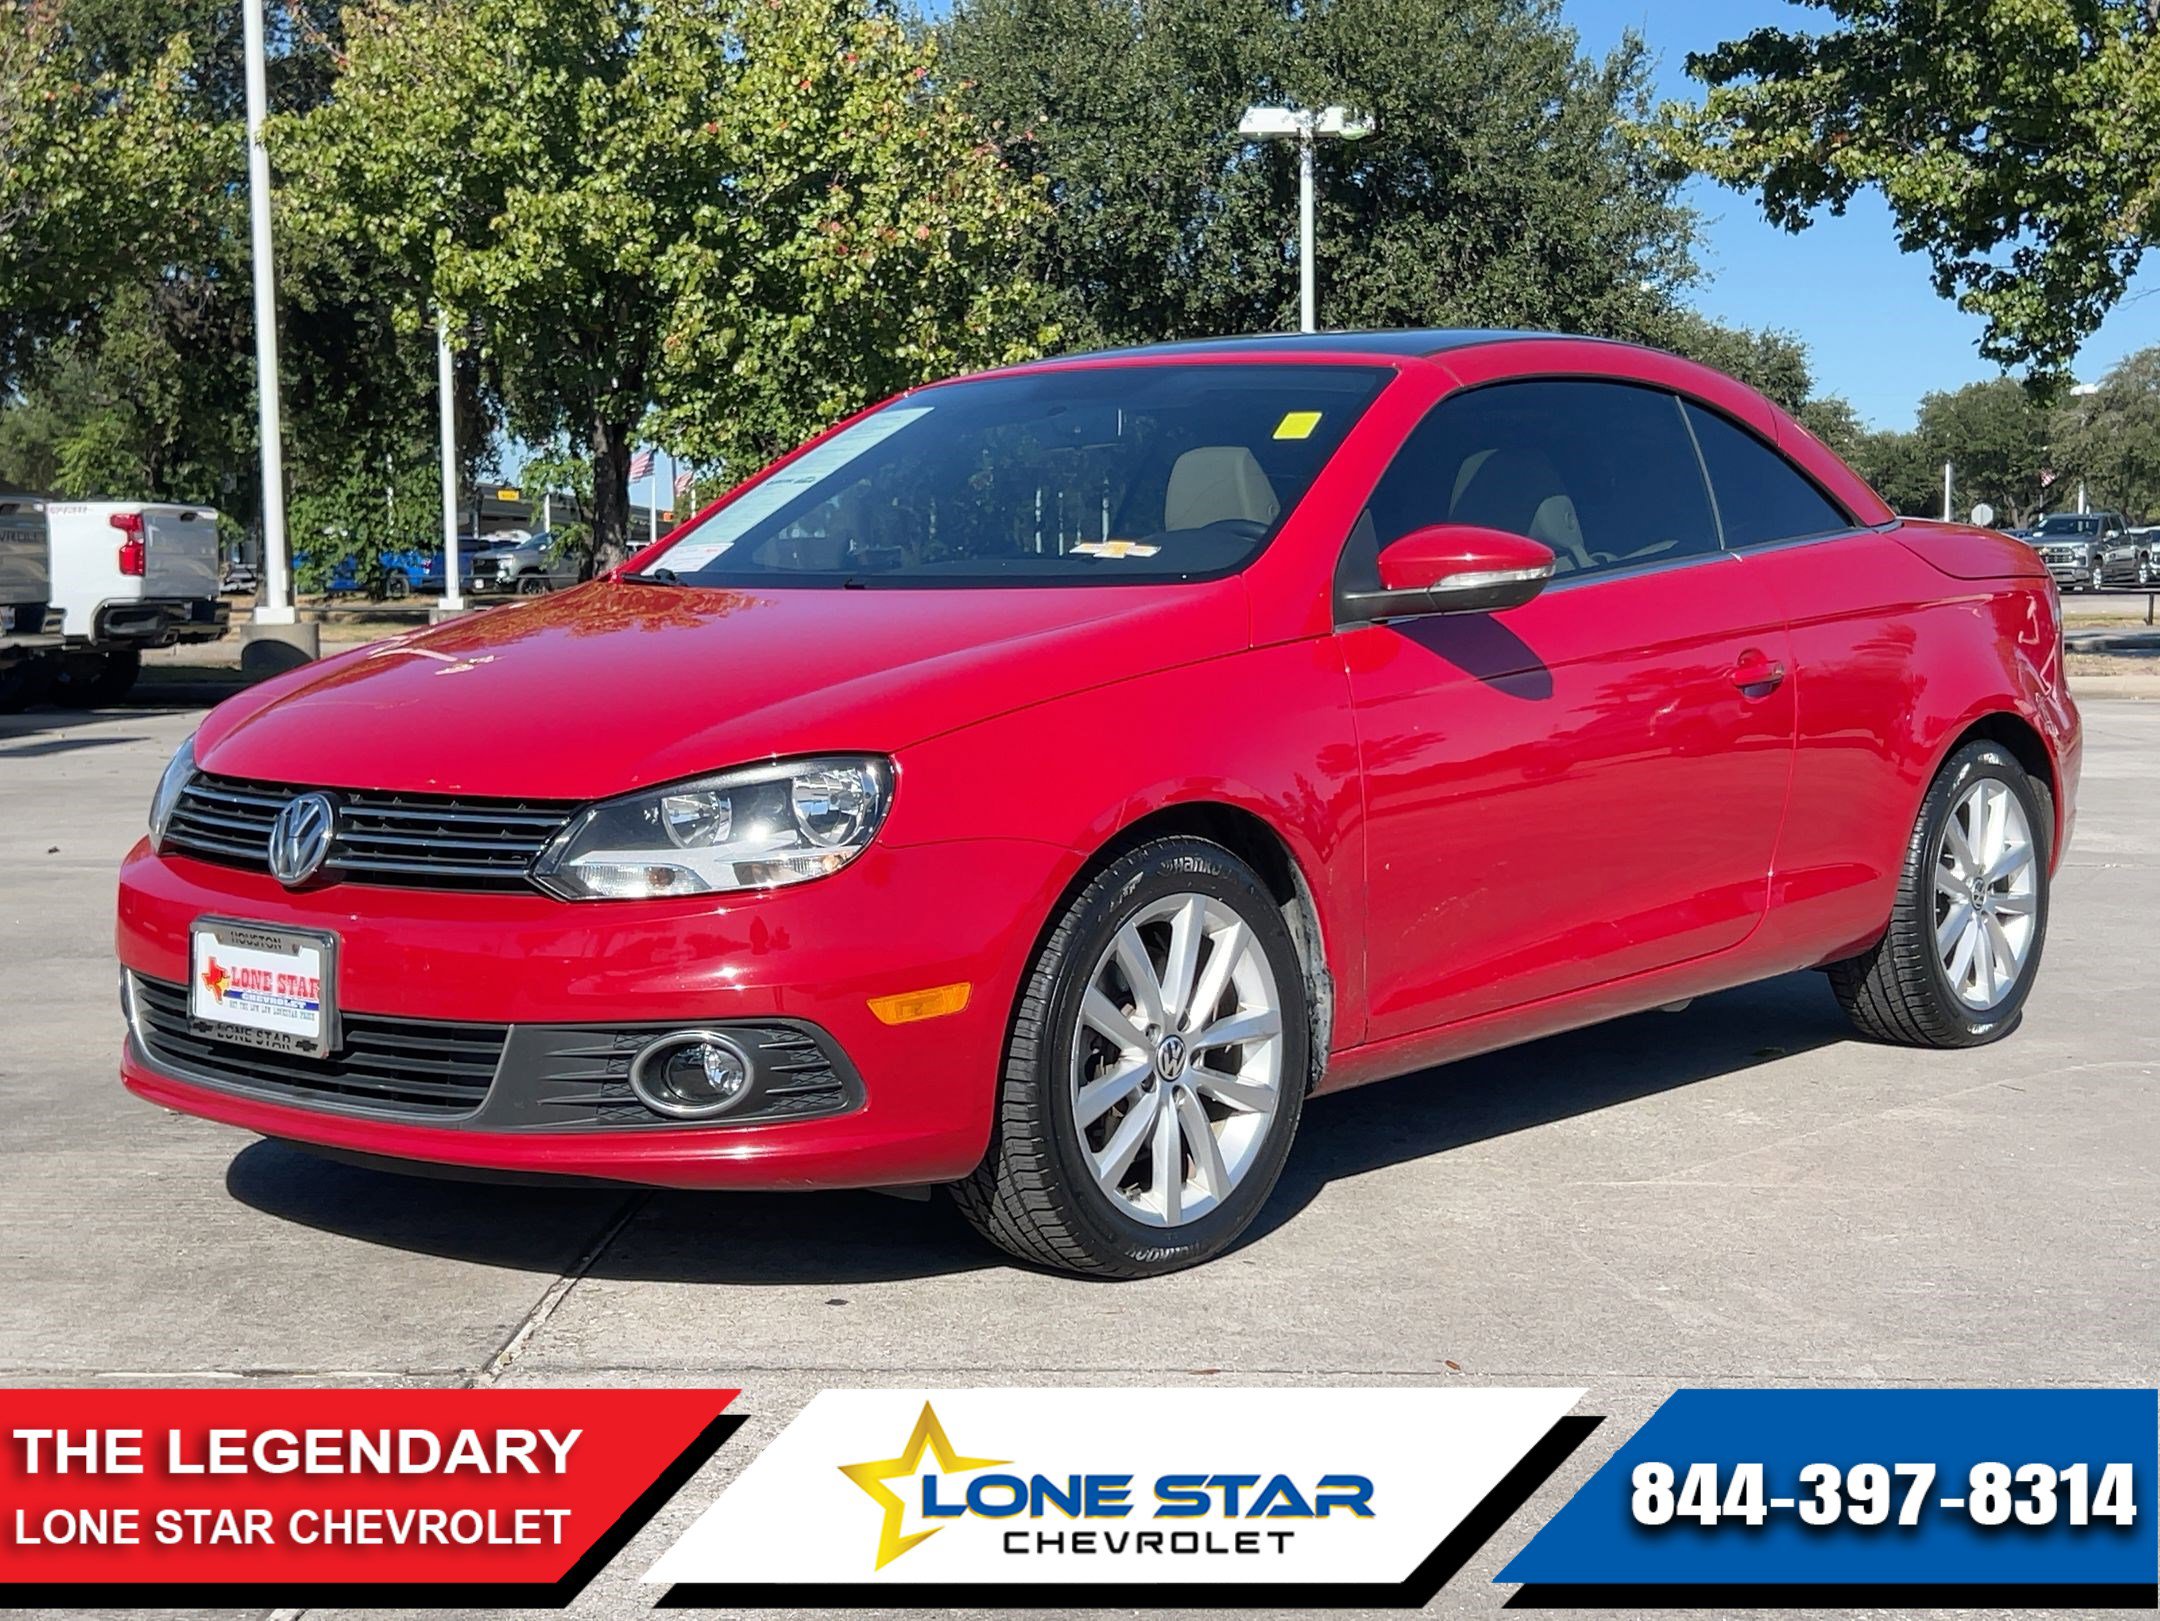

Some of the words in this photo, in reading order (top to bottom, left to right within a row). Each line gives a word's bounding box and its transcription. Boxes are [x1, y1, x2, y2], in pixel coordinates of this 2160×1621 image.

[230, 930, 283, 950] HOUSTON
[231, 966, 273, 992] LONE
[241, 991, 307, 1010] CHEVROLET
[216, 1022, 253, 1043] LONE
[256, 1028, 292, 1051] STAR
